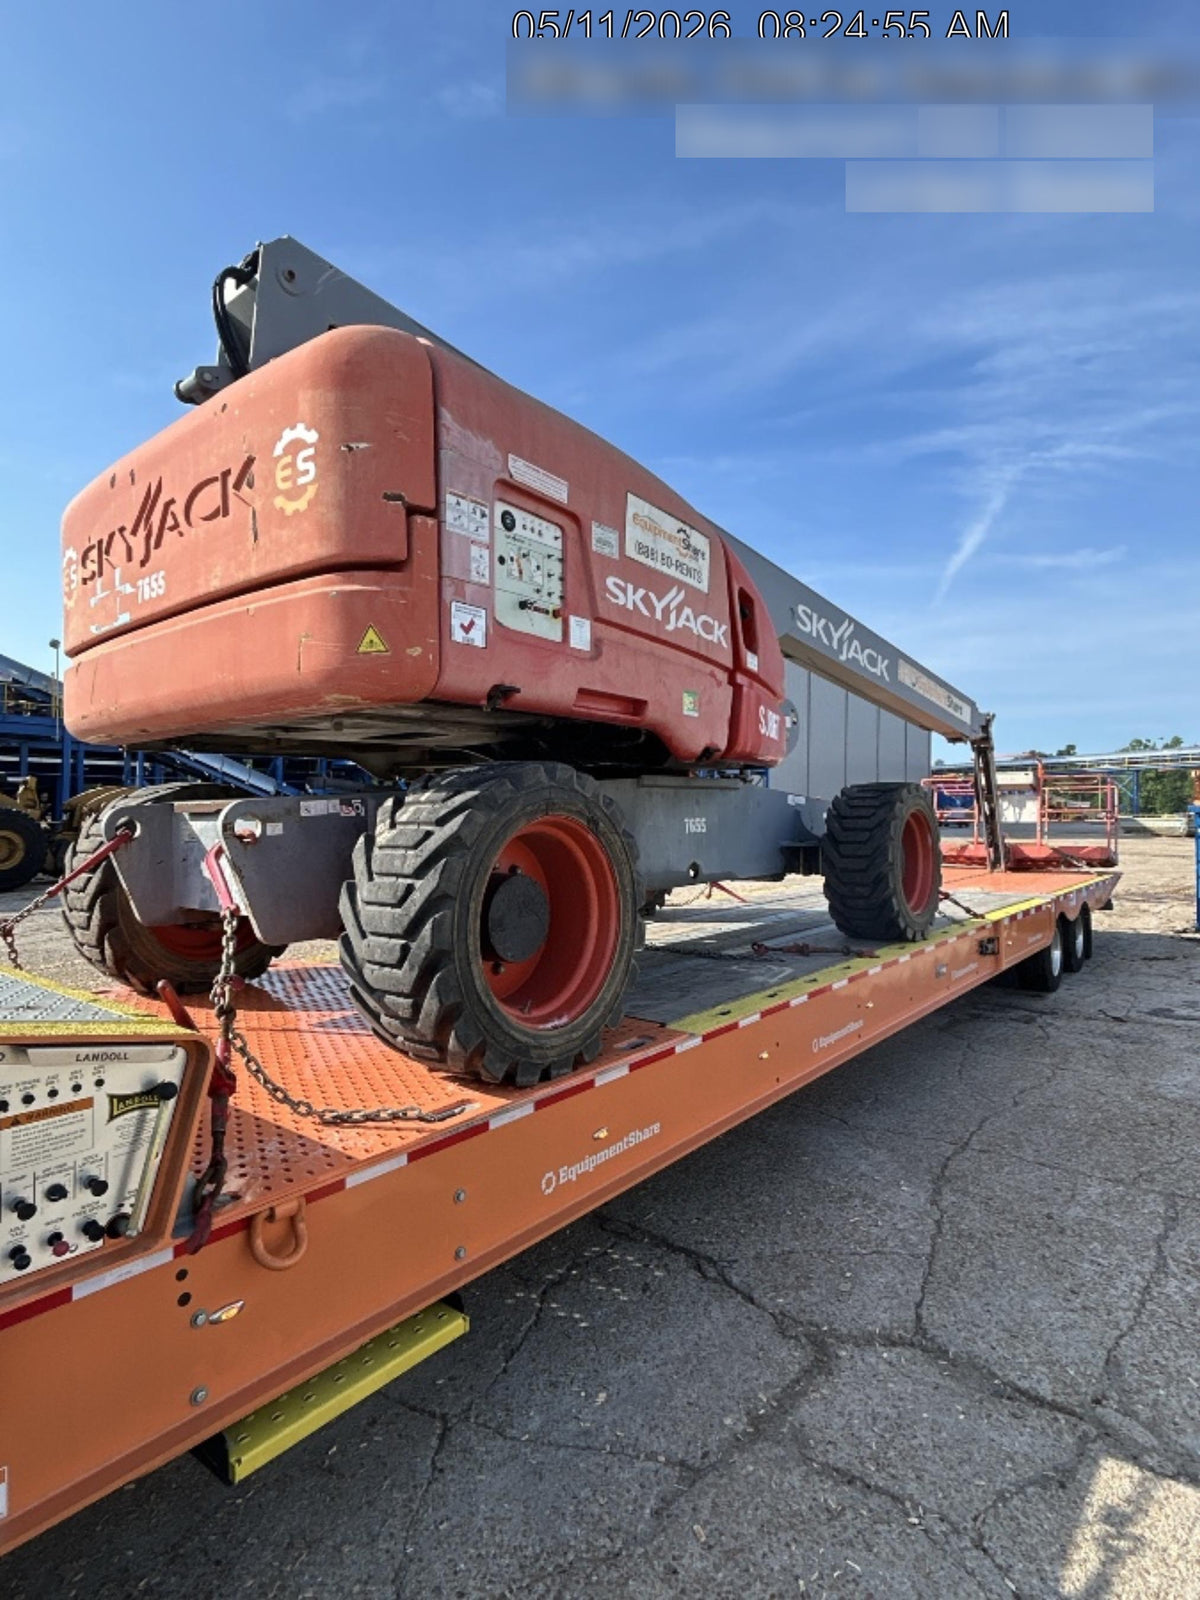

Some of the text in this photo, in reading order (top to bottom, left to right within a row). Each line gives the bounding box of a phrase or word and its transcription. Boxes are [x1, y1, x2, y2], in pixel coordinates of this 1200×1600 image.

[81, 454, 256, 585] SKYJACK
[137, 570, 166, 604] 7655
[605, 575, 728, 648] SKYJACK
[796, 604, 890, 682] SKYJACK
[75, 1053, 129, 1062] LANDOLL
[558, 1121, 661, 1185] EquipmentShare
